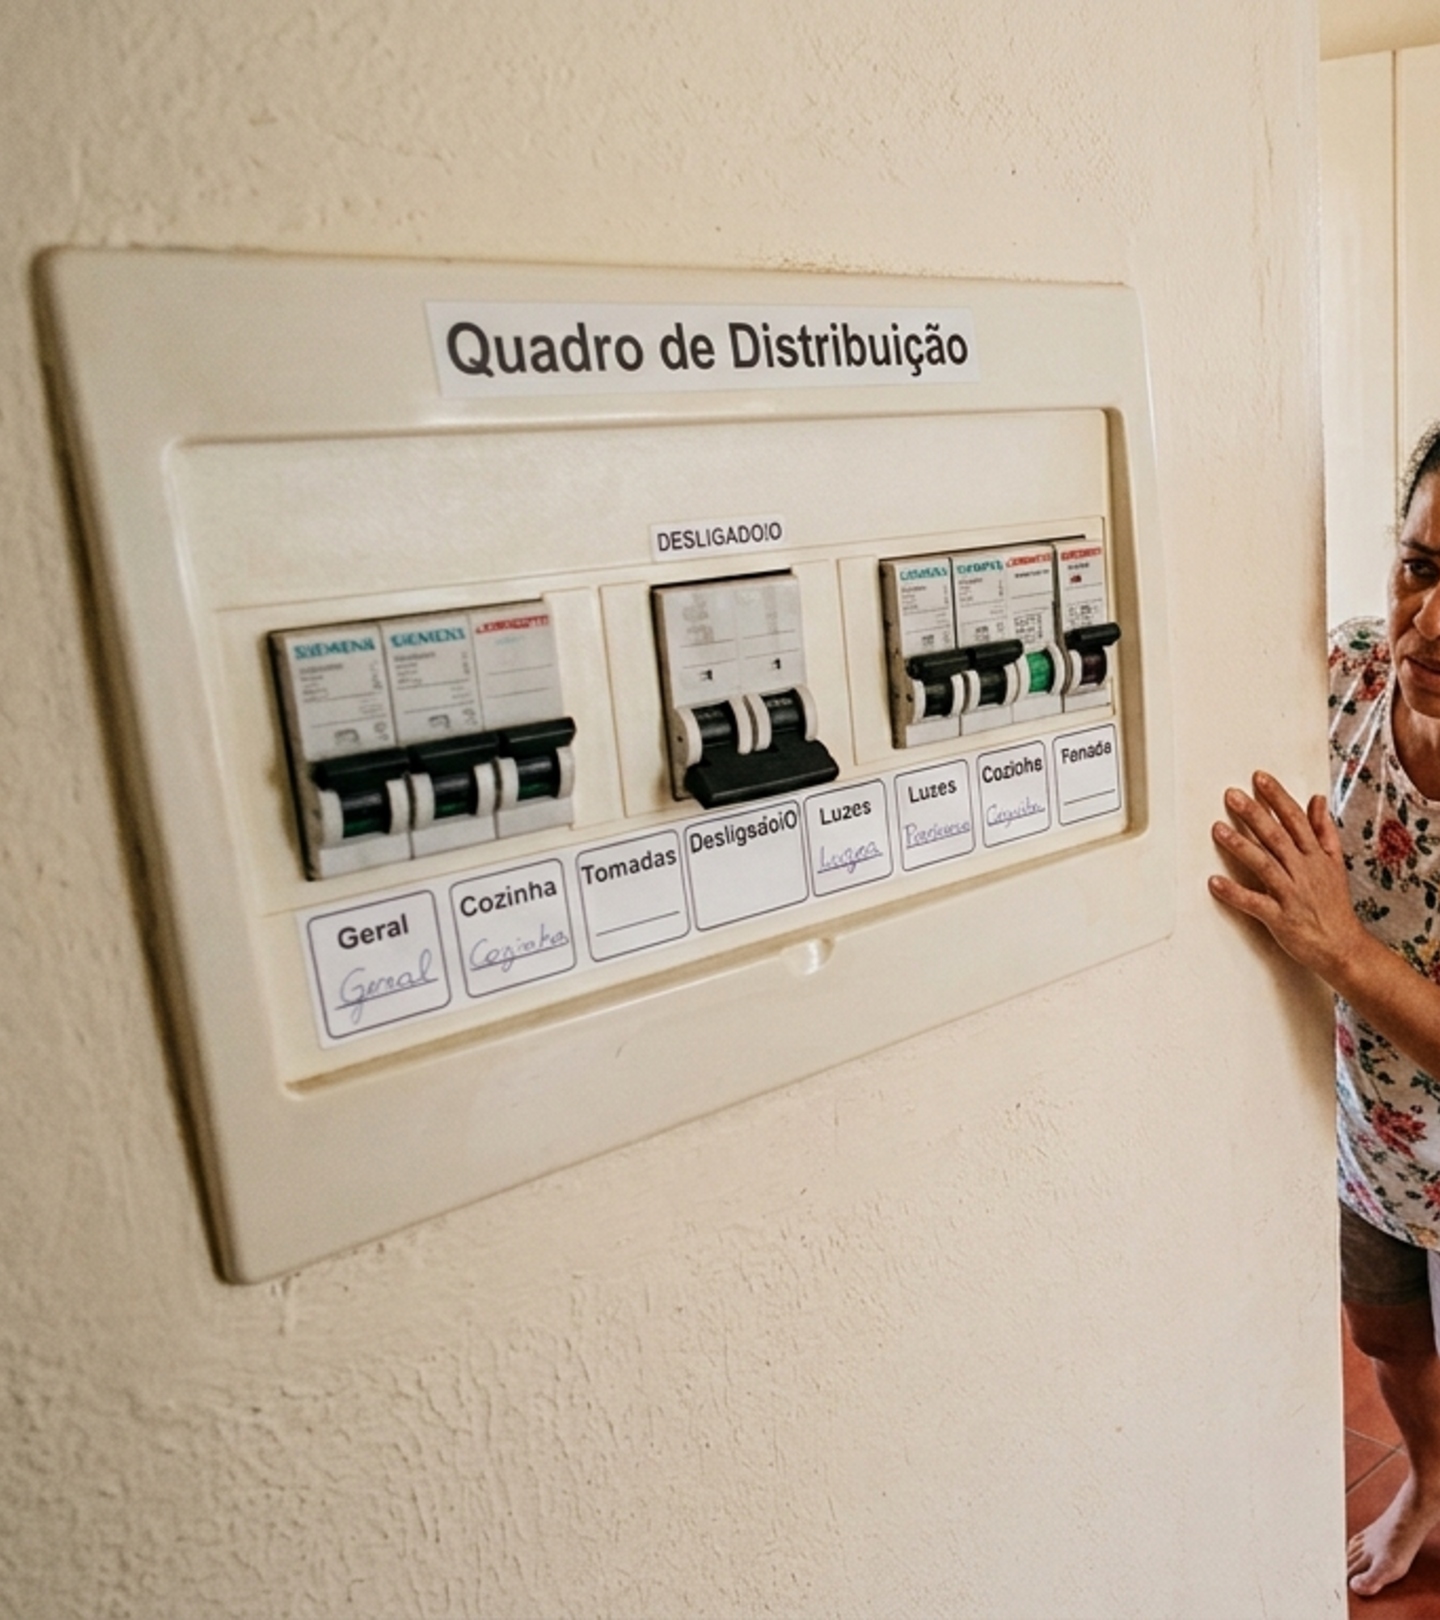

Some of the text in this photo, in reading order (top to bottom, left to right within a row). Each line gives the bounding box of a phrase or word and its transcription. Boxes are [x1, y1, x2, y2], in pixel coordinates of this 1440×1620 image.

[446, 321, 970, 378] Quadro de Distribuição
[907, 778, 958, 804] Luzes
[819, 799, 872, 826] Luzes
[580, 847, 678, 885] Tomadas
[459, 879, 558, 918] Cozinha
[337, 912, 410, 950] Geral
